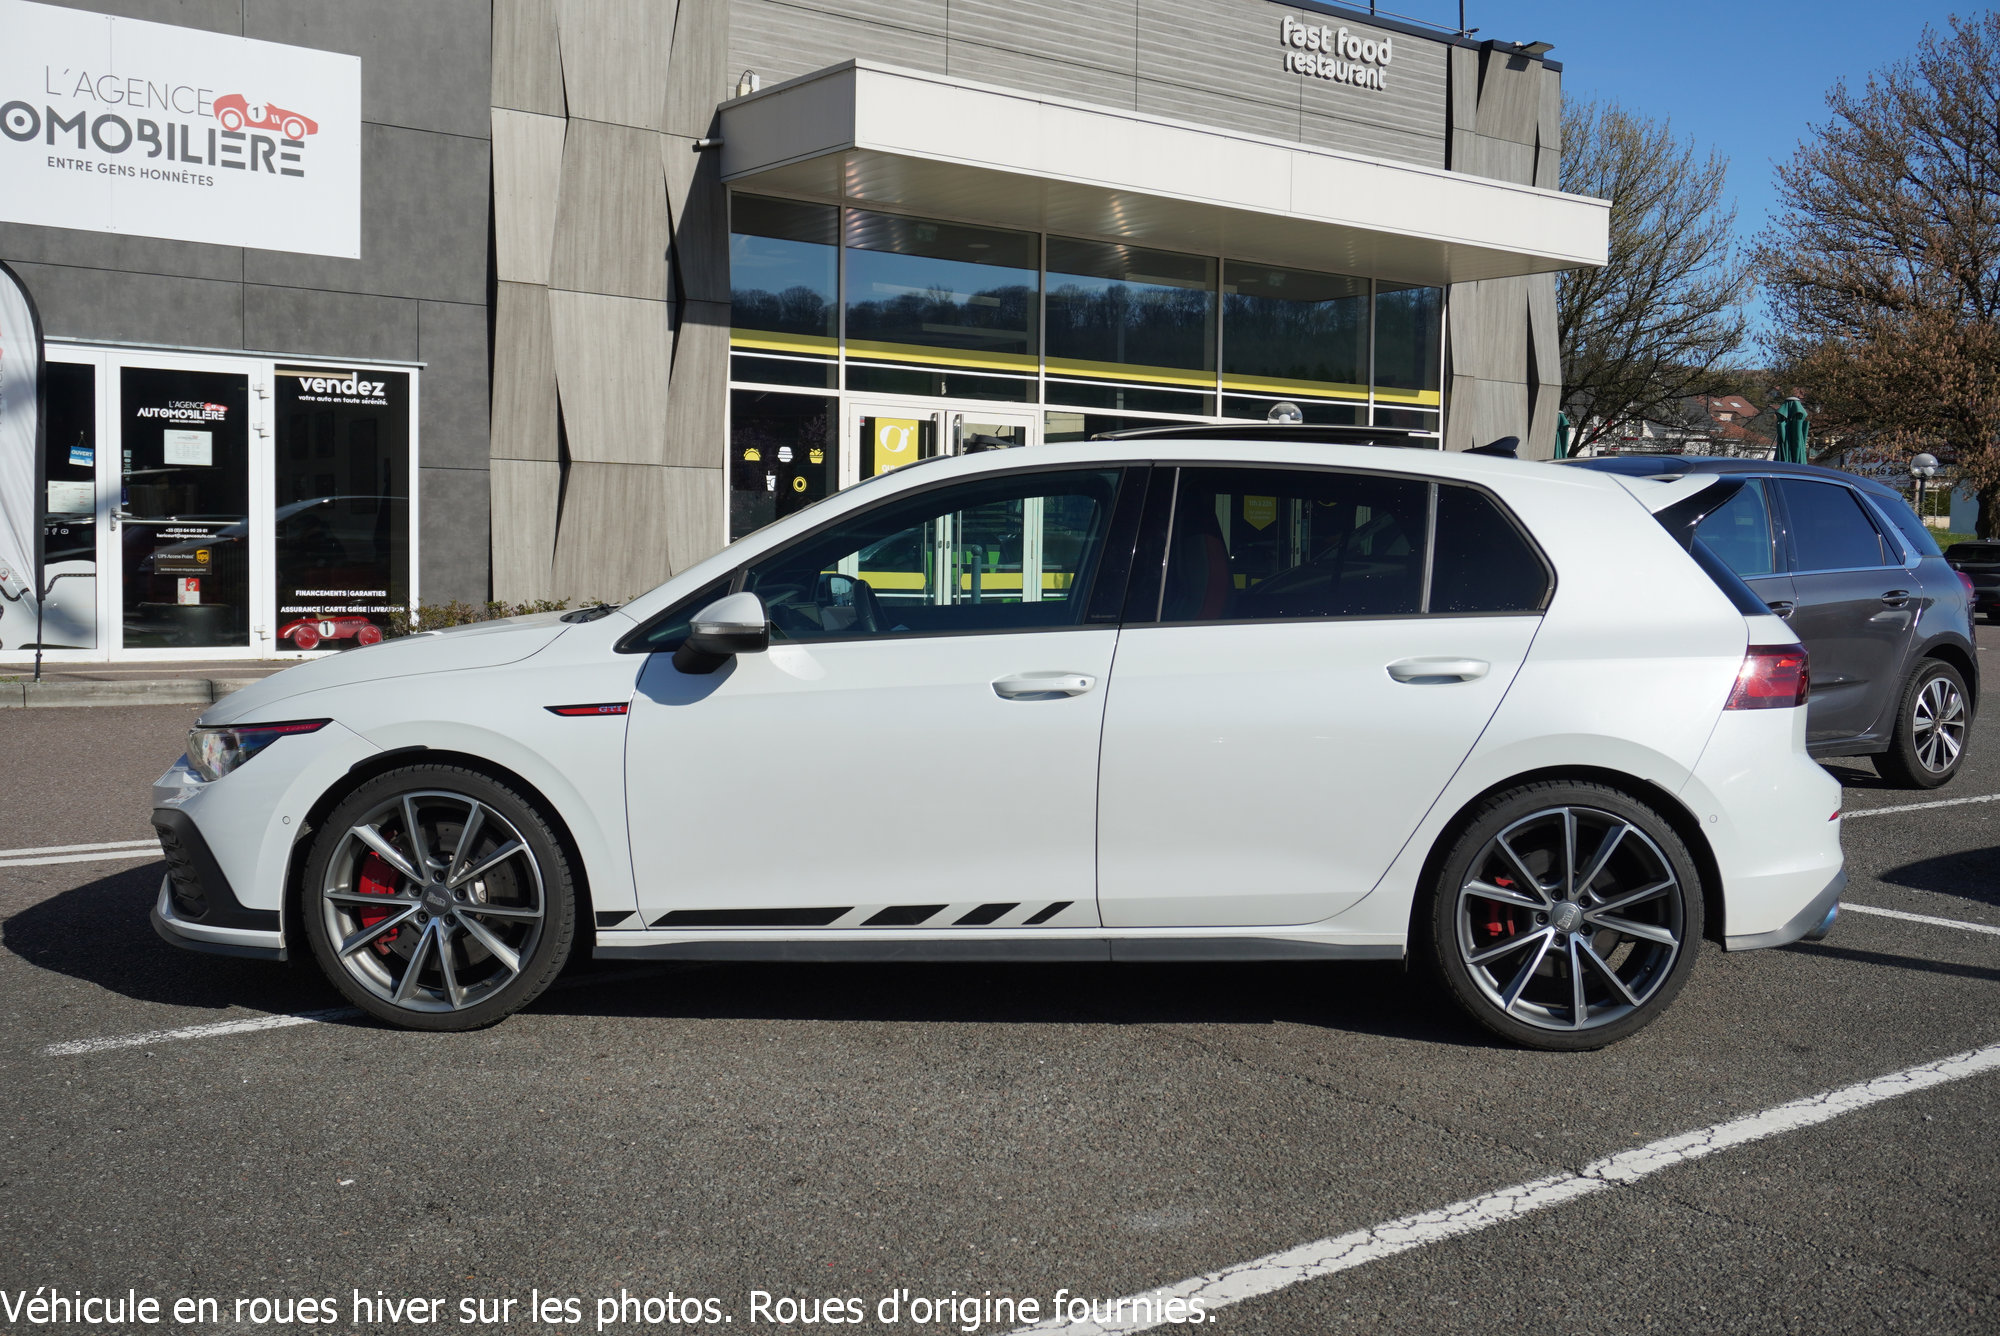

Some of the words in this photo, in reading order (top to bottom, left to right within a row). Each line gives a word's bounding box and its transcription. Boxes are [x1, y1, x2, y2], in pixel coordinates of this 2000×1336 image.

[1281, 15, 1332, 53] fast
[1335, 27, 1392, 66] food
[1284, 51, 1387, 91] restaurant
[48, 156, 93, 172] ENTRE
[97, 162, 136, 177] GENS
[140, 168, 214, 187] HONNÊTES
[299, 372, 385, 396] vendez
[599, 705, 622, 713] GTI
